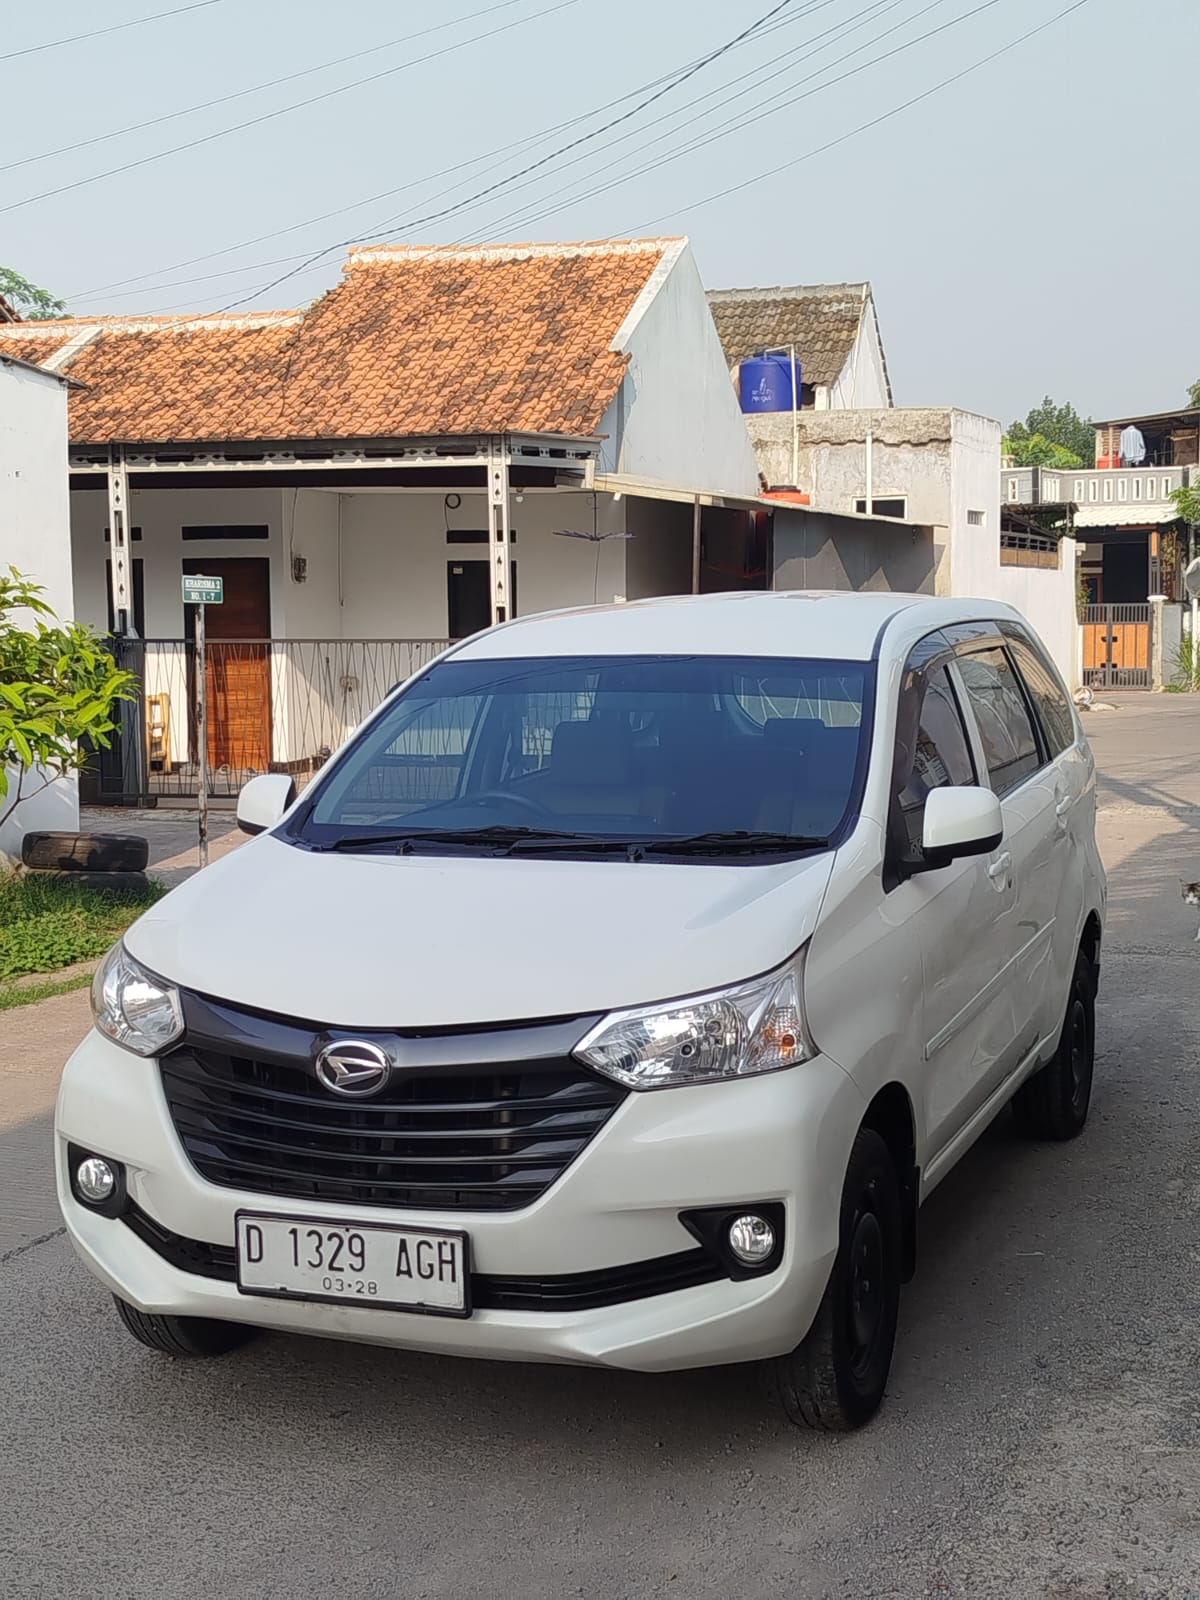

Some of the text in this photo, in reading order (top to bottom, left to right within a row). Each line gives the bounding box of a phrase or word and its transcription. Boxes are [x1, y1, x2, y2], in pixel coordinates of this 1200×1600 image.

[246, 1224, 457, 1283] D 1329 AGH
